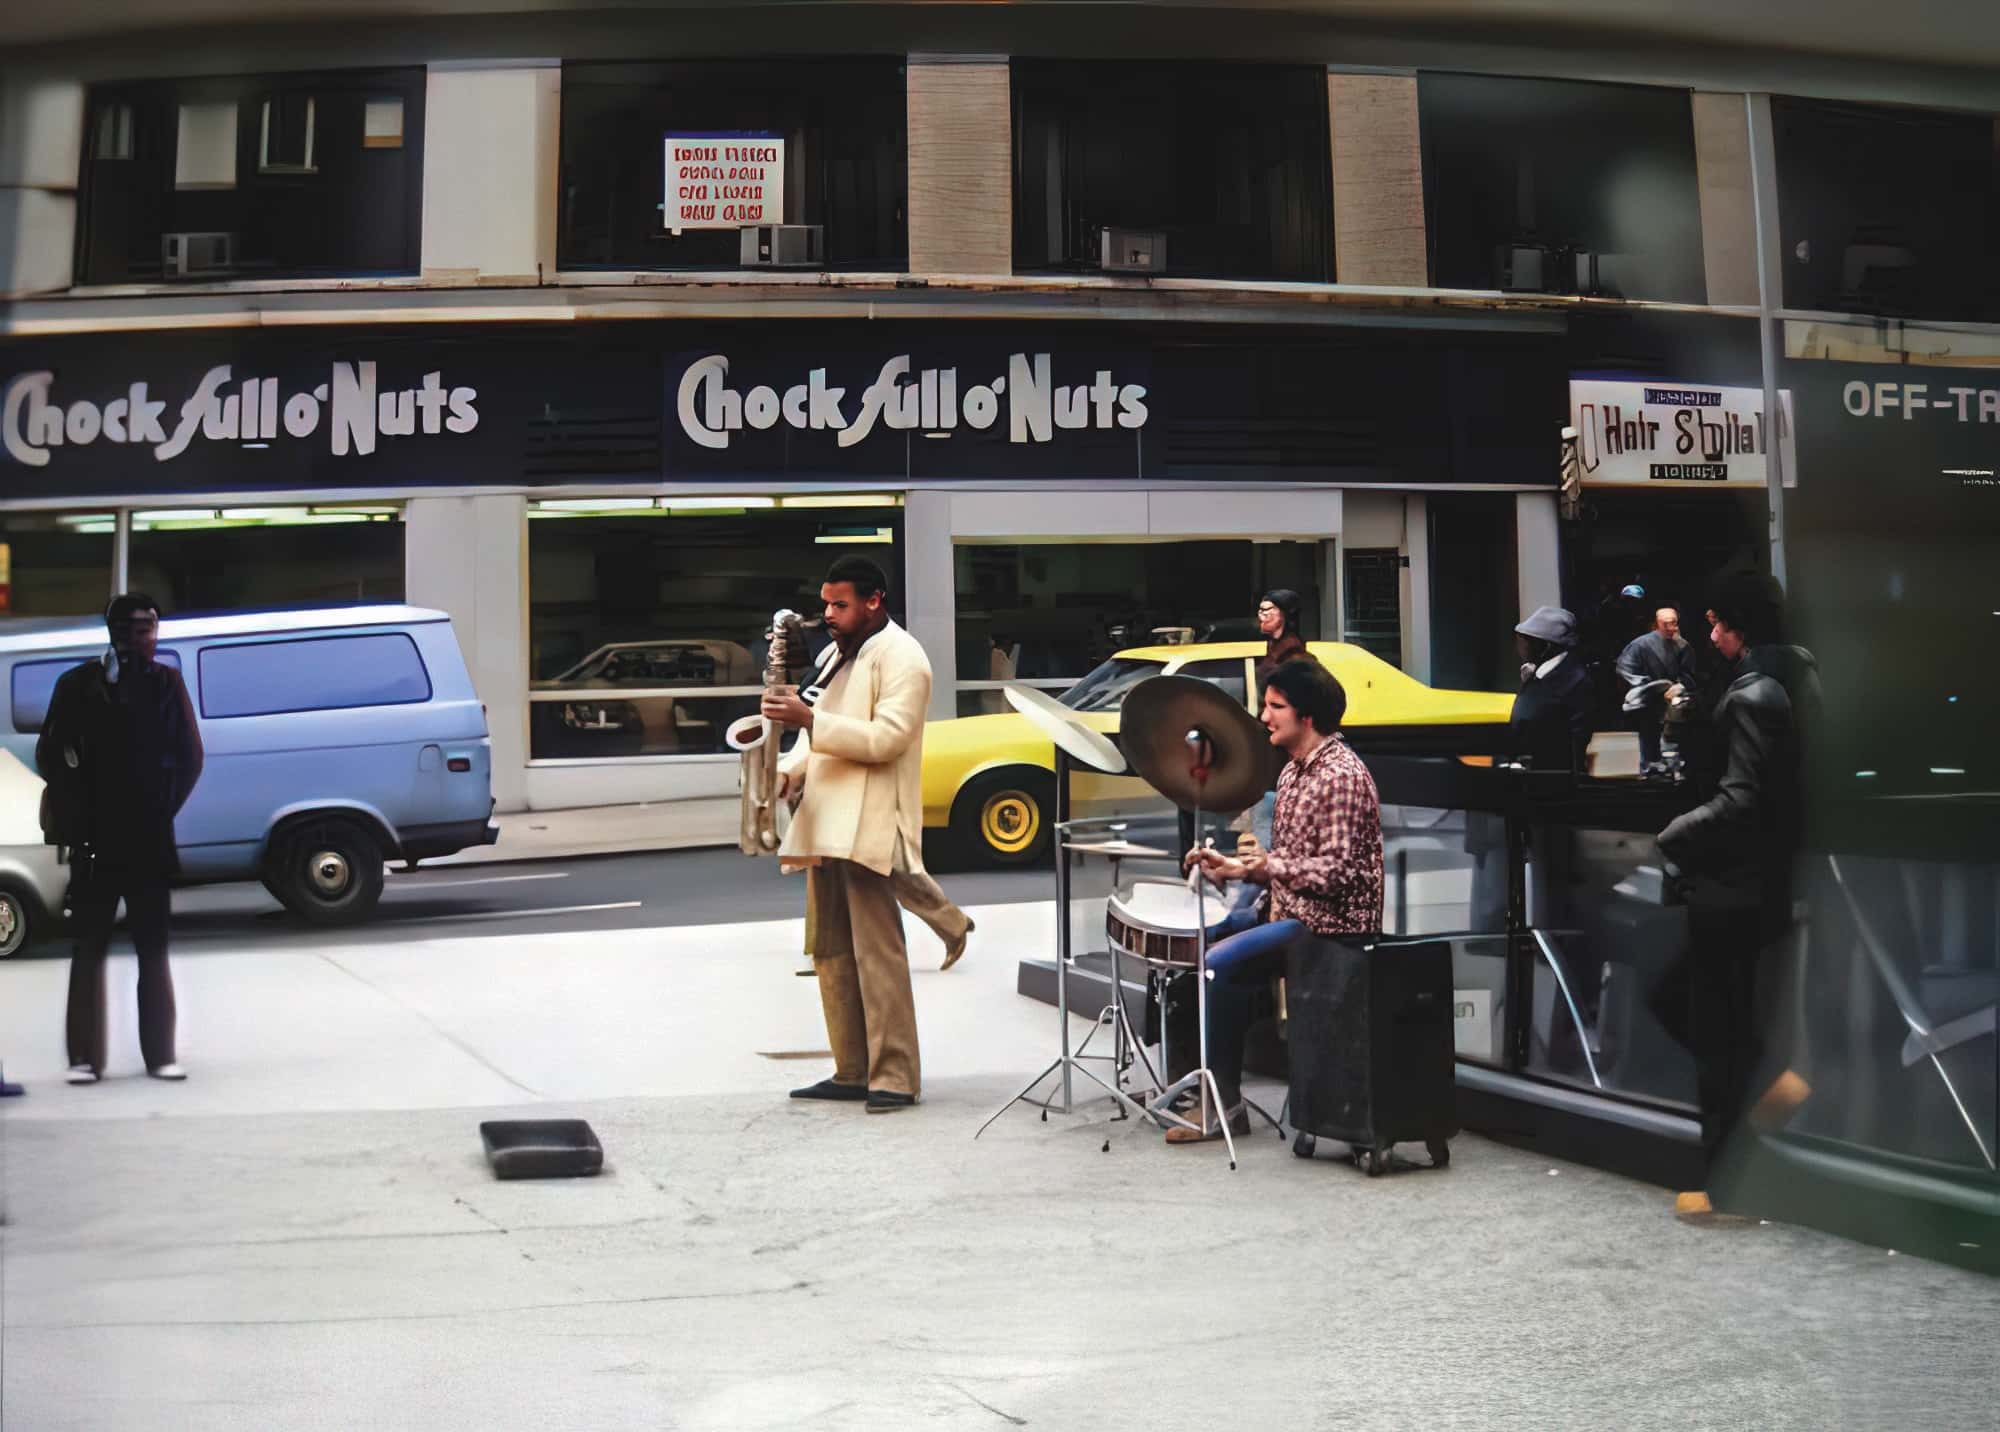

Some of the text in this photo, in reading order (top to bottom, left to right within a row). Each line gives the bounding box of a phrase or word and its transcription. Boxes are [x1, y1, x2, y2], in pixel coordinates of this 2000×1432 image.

[3, 372, 167, 466] Chock
[331, 361, 479, 456] Nuts
[678, 354, 847, 448] Chock
[1009, 353, 1149, 443] Nuts
[1603, 405, 1660, 454] Hair
